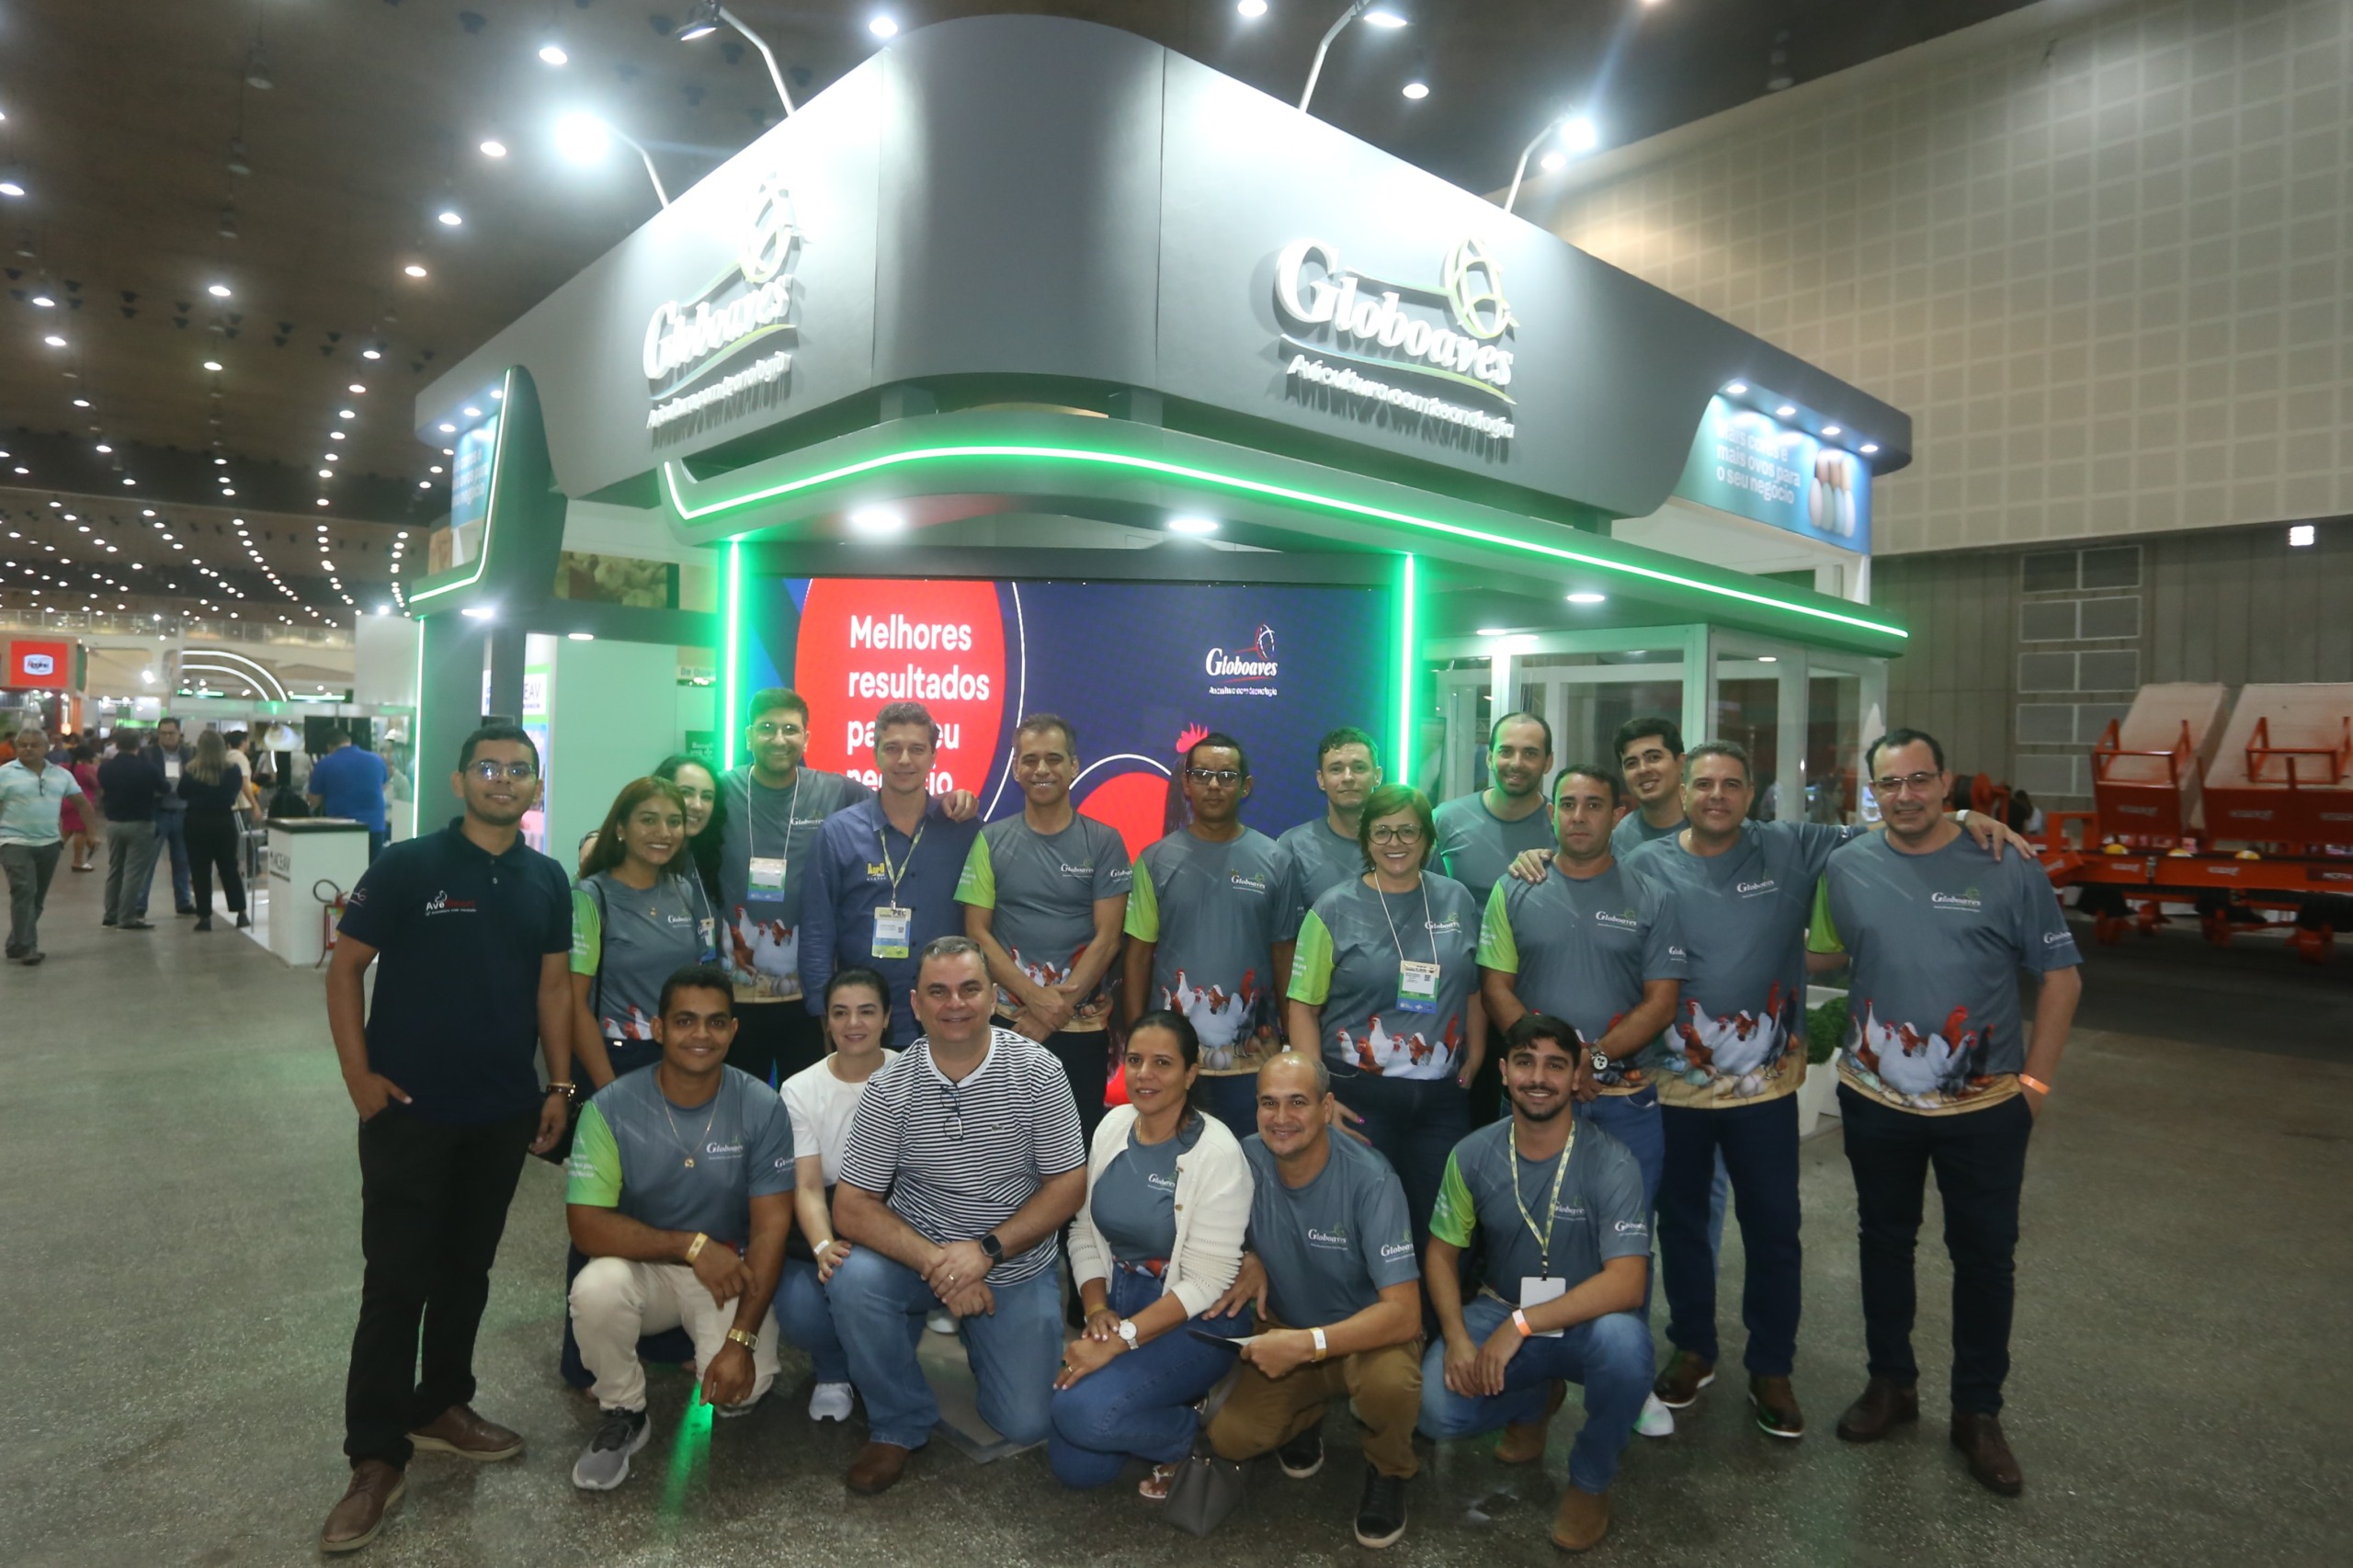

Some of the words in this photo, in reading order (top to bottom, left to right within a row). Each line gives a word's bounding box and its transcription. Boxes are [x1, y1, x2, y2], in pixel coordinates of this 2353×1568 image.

[1275, 238, 1514, 385] Globoaves
[1287, 354, 1389, 401] Avicultura
[1428, 397, 1515, 439] tecnologia
[1717, 444, 1746, 468] mais
[1747, 455, 1775, 478] ovos
[1775, 466, 1802, 488] para
[1727, 469, 1749, 489] seu
[849, 613, 972, 652] Melhores
[1205, 647, 1278, 676] Globoaves
[847, 664, 990, 701] resultados
[1308, 1228, 1347, 1244] Globoaves
